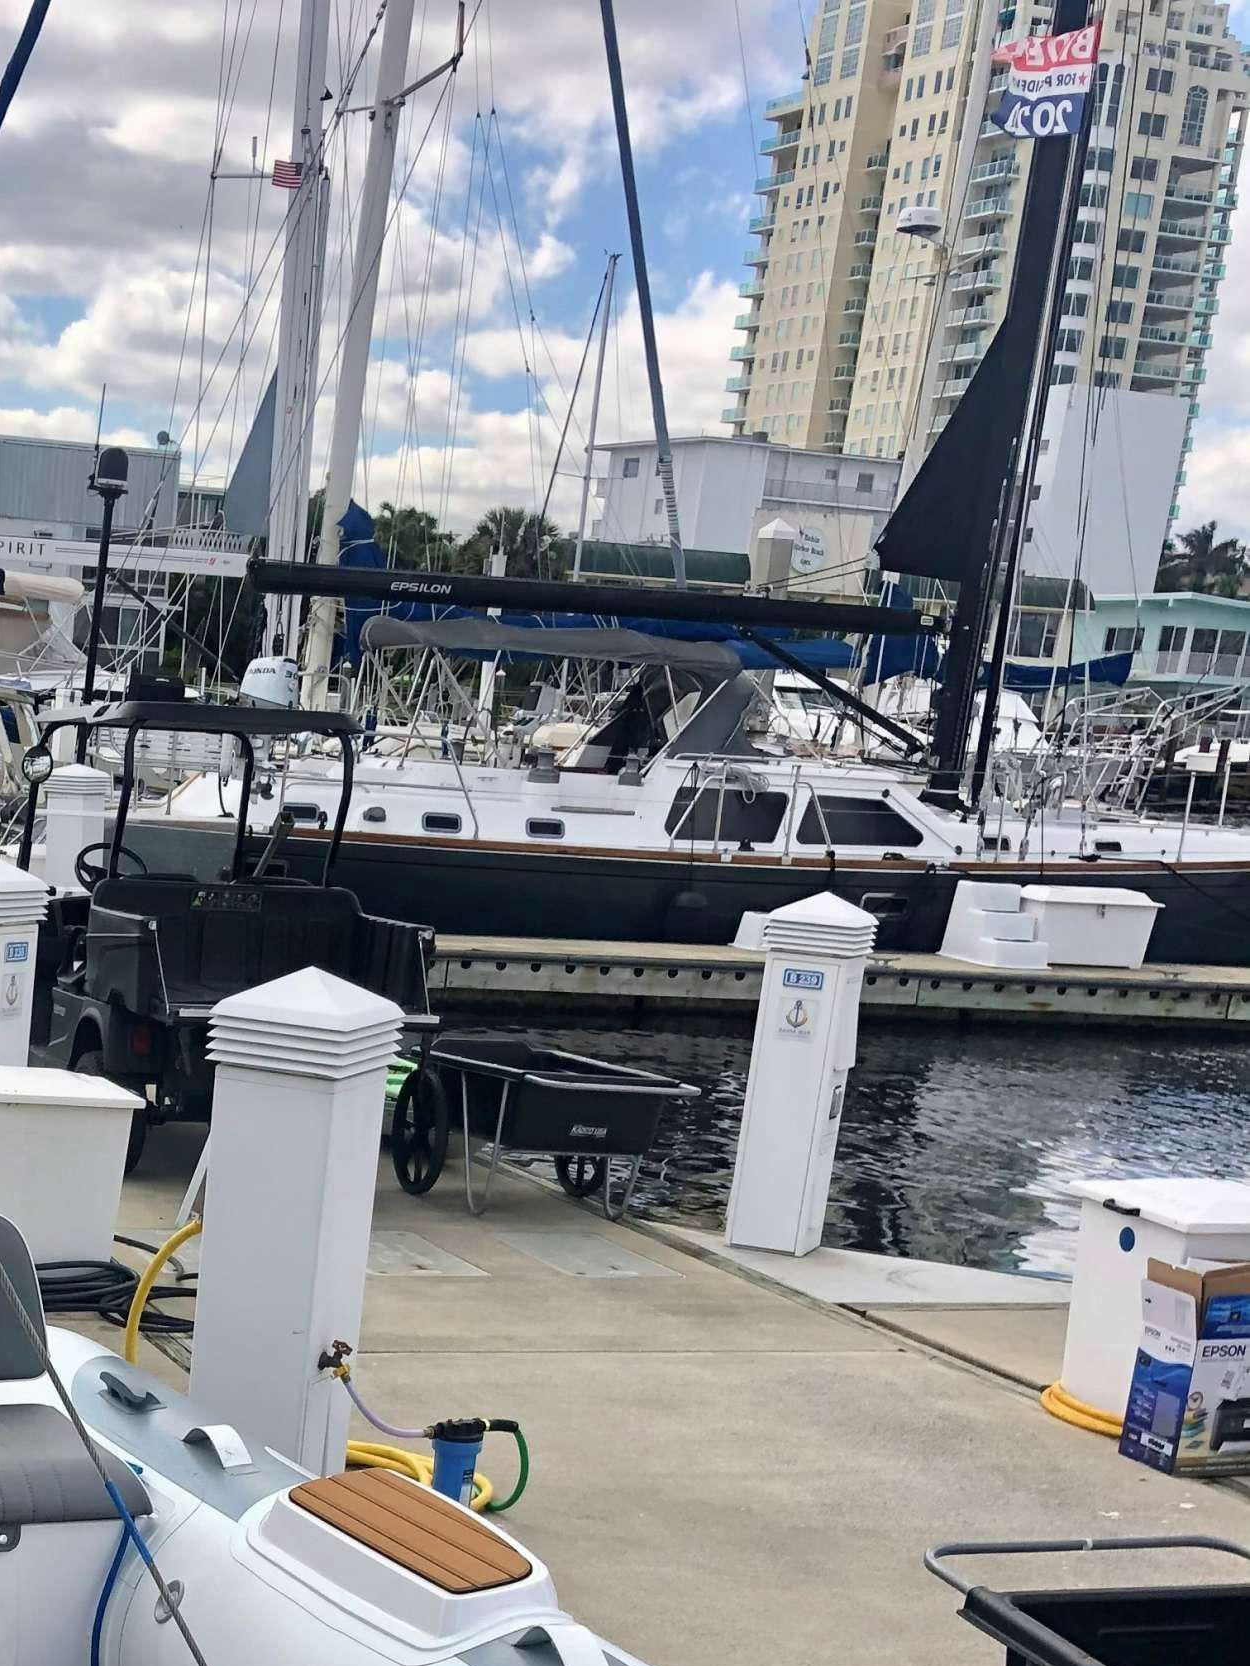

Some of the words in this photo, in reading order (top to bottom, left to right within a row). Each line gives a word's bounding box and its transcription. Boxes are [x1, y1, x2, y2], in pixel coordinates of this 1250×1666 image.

[390, 581, 452, 594] EPSILON
[789, 971, 797, 984] B
[798, 974, 818, 986] 239
[1201, 1344, 1246, 1358] EPSON
